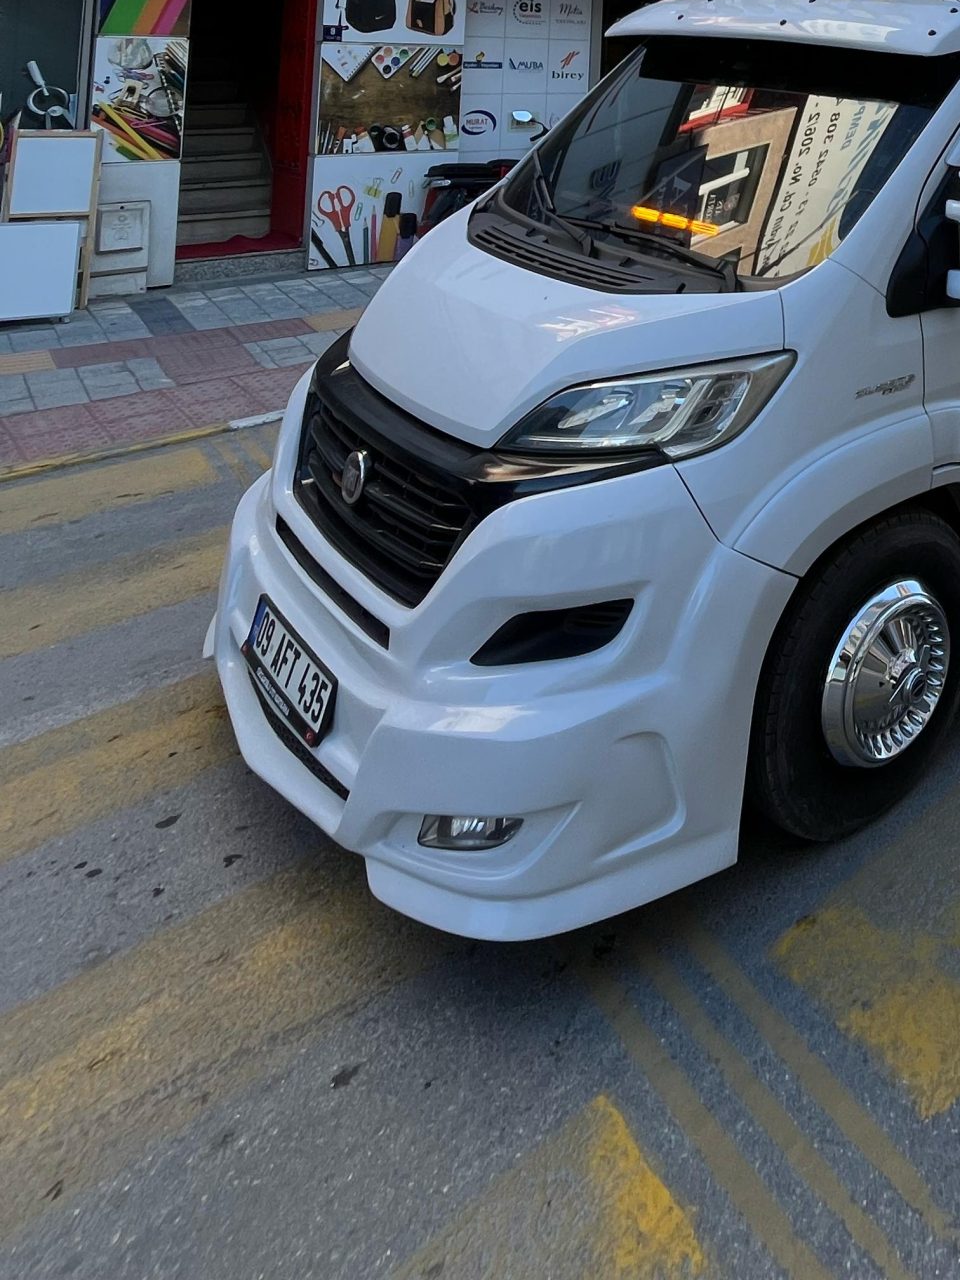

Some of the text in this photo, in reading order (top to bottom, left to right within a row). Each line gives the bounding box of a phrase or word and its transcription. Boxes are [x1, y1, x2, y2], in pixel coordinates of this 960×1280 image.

[552, 70, 584, 81] birey
[256, 612, 276, 657] 09
[270, 633, 301, 689] AFT
[297, 663, 328, 724] 435
